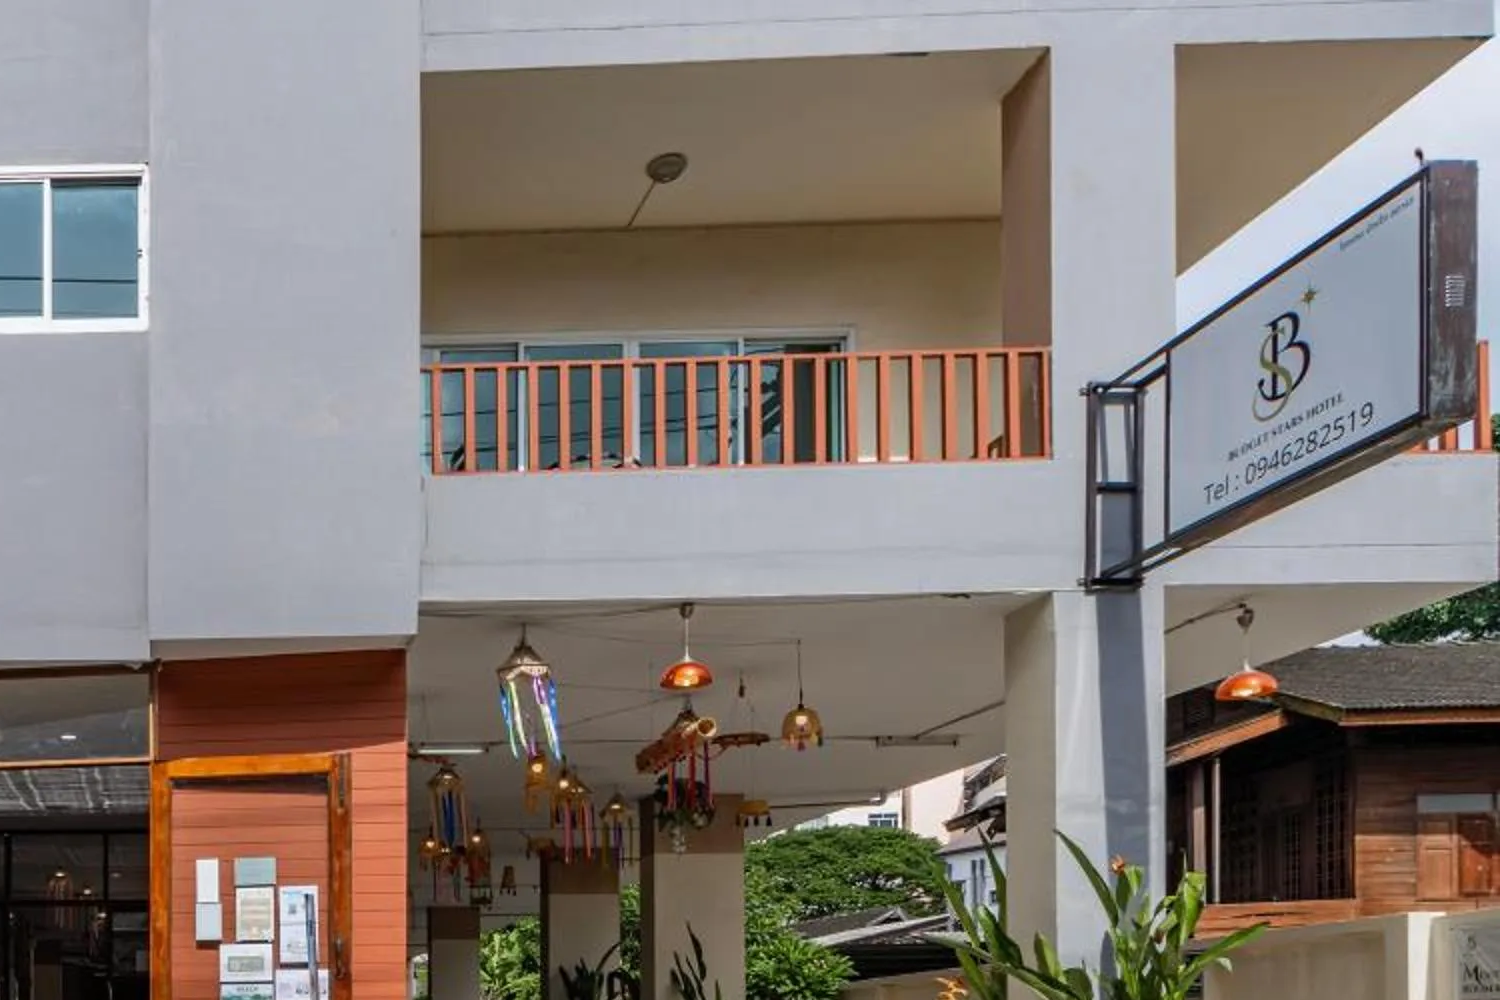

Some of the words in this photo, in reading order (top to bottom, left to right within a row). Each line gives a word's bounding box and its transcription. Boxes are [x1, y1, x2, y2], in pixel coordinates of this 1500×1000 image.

[1245, 402, 1374, 485] 0946282519
[1272, 413, 1304, 437] STARS
[1306, 392, 1343, 420] HOTEL
